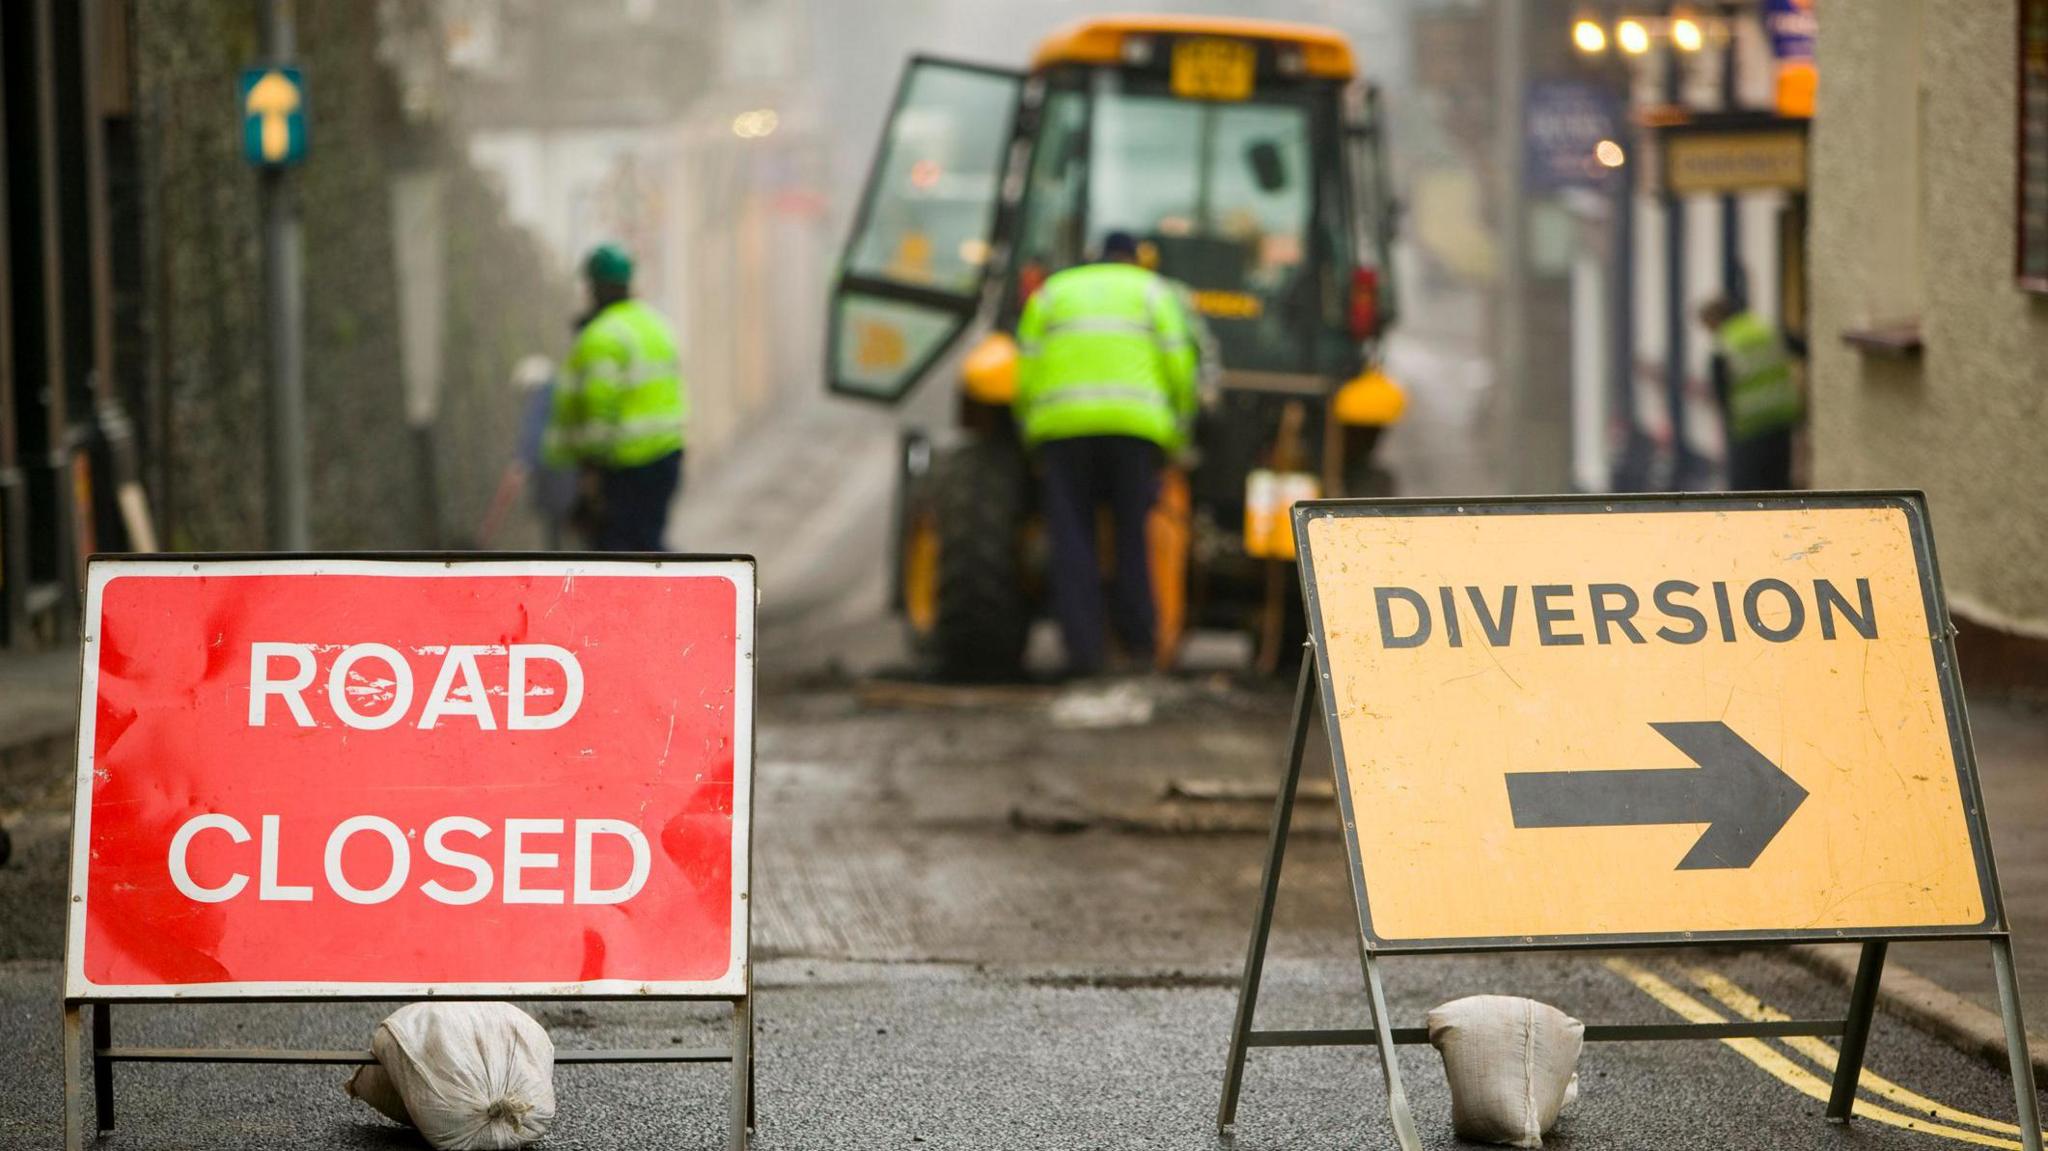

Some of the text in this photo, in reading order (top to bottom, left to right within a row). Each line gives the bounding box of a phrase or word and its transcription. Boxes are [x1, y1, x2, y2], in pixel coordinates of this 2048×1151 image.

[1374, 578, 1879, 648] DIVERSION
[248, 642, 584, 731] ROAD
[169, 813, 652, 906] CLOSED
